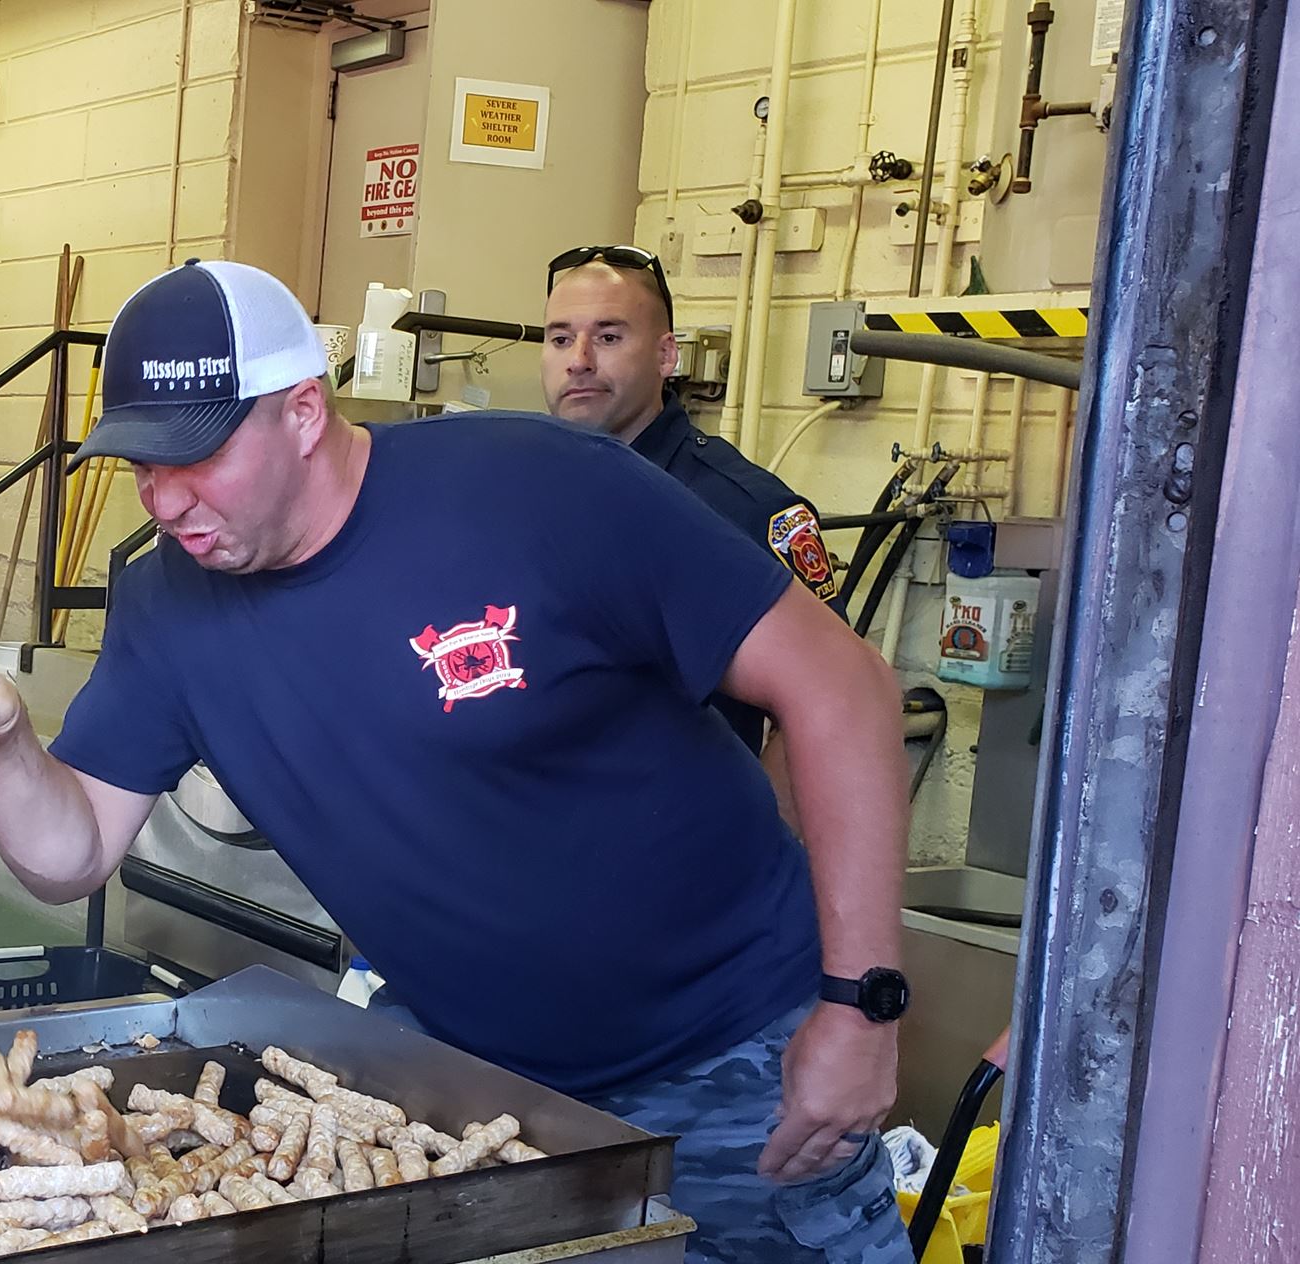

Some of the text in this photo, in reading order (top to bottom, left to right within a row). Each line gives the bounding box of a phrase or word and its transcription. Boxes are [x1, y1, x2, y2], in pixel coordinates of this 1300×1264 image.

[486, 99, 517, 110] SEVERE
[480, 110, 521, 122] WEATHER
[481, 122, 518, 133] SHELTER
[487, 134, 512, 144] ROOM
[380, 159, 417, 181] NO
[365, 182, 390, 202] FIRE
[367, 207, 388, 218] beyond
[389, 206, 401, 214] this
